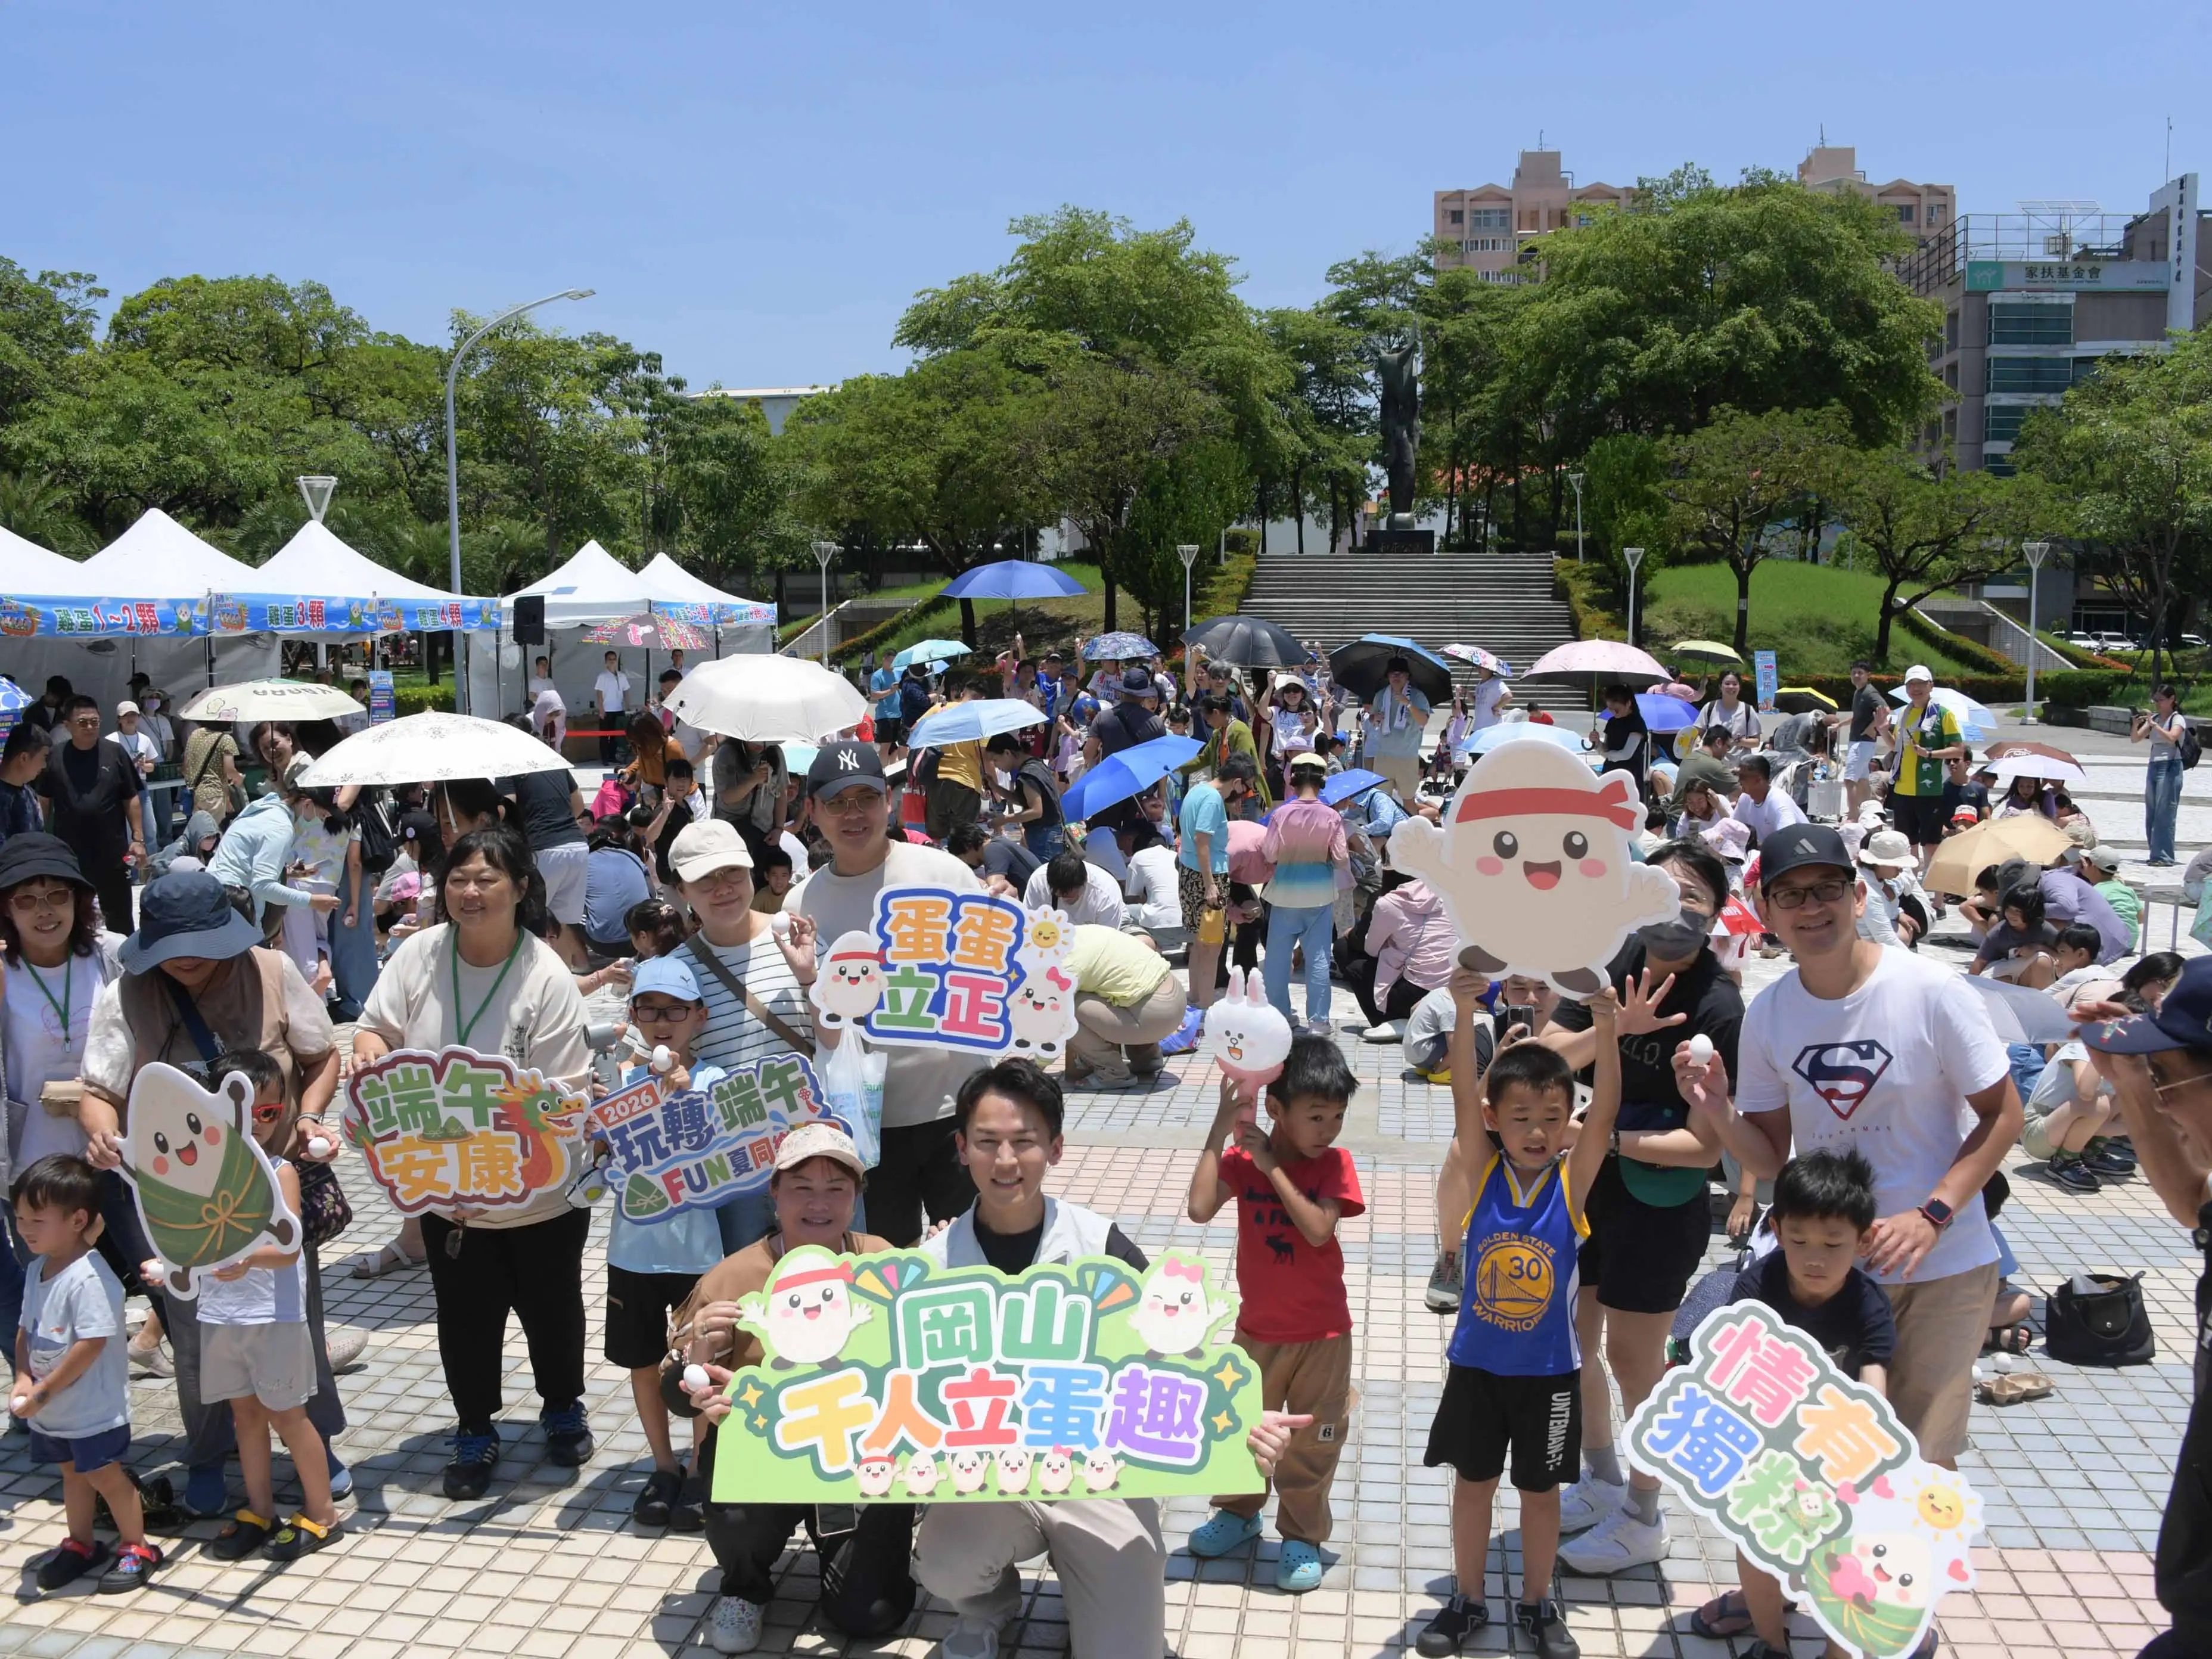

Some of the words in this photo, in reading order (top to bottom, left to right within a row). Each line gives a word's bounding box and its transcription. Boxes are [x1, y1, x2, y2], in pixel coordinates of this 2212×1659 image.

[2025, 266, 2101, 279] 家扶基金會
[54, 602, 160, 635] 雞蛋1~2顆
[268, 598, 325, 629] 雞蛋3顆
[418, 602, 462, 627] 雞蛋4顆
[837, 748, 860, 771] NY
[888, 899, 1015, 971] 蛋蛋
[875, 967, 1004, 1037] 立正
[361, 1063, 504, 1131] 端午
[604, 1091, 653, 1123] 2026
[608, 1060, 807, 1174] 玩轉端午
[380, 1130, 520, 1201] 安康
[1477, 1232, 1519, 1253] GOLDEN
[1522, 1234, 1557, 1257] STATE
[1508, 1256, 1542, 1281] 30
[902, 1285, 1085, 1368] 岡山
[781, 1366, 1201, 1468] 千人立蛋趣
[1707, 1319, 1897, 1483] 情有
[1647, 1387, 1837, 1560] 獨粽
